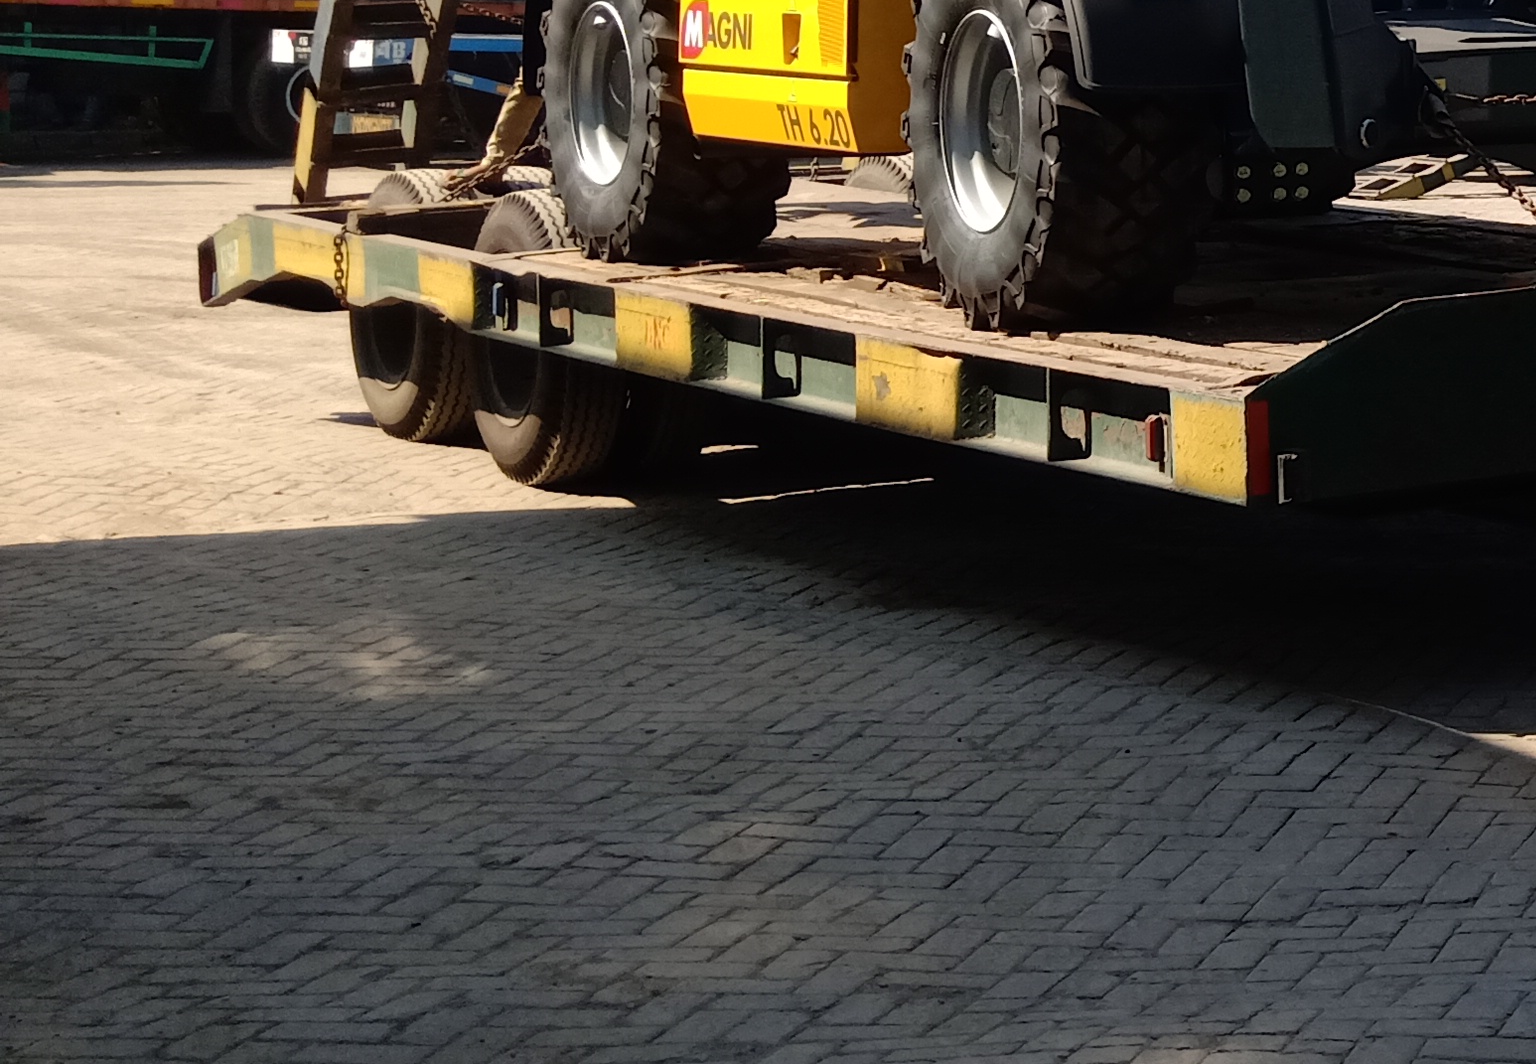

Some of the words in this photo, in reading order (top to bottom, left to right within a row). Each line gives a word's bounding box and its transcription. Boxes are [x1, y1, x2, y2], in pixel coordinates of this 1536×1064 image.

[684, 10, 752, 50] MAGNI
[776, 104, 805, 142] TH
[808, 108, 850, 149] 6.20
